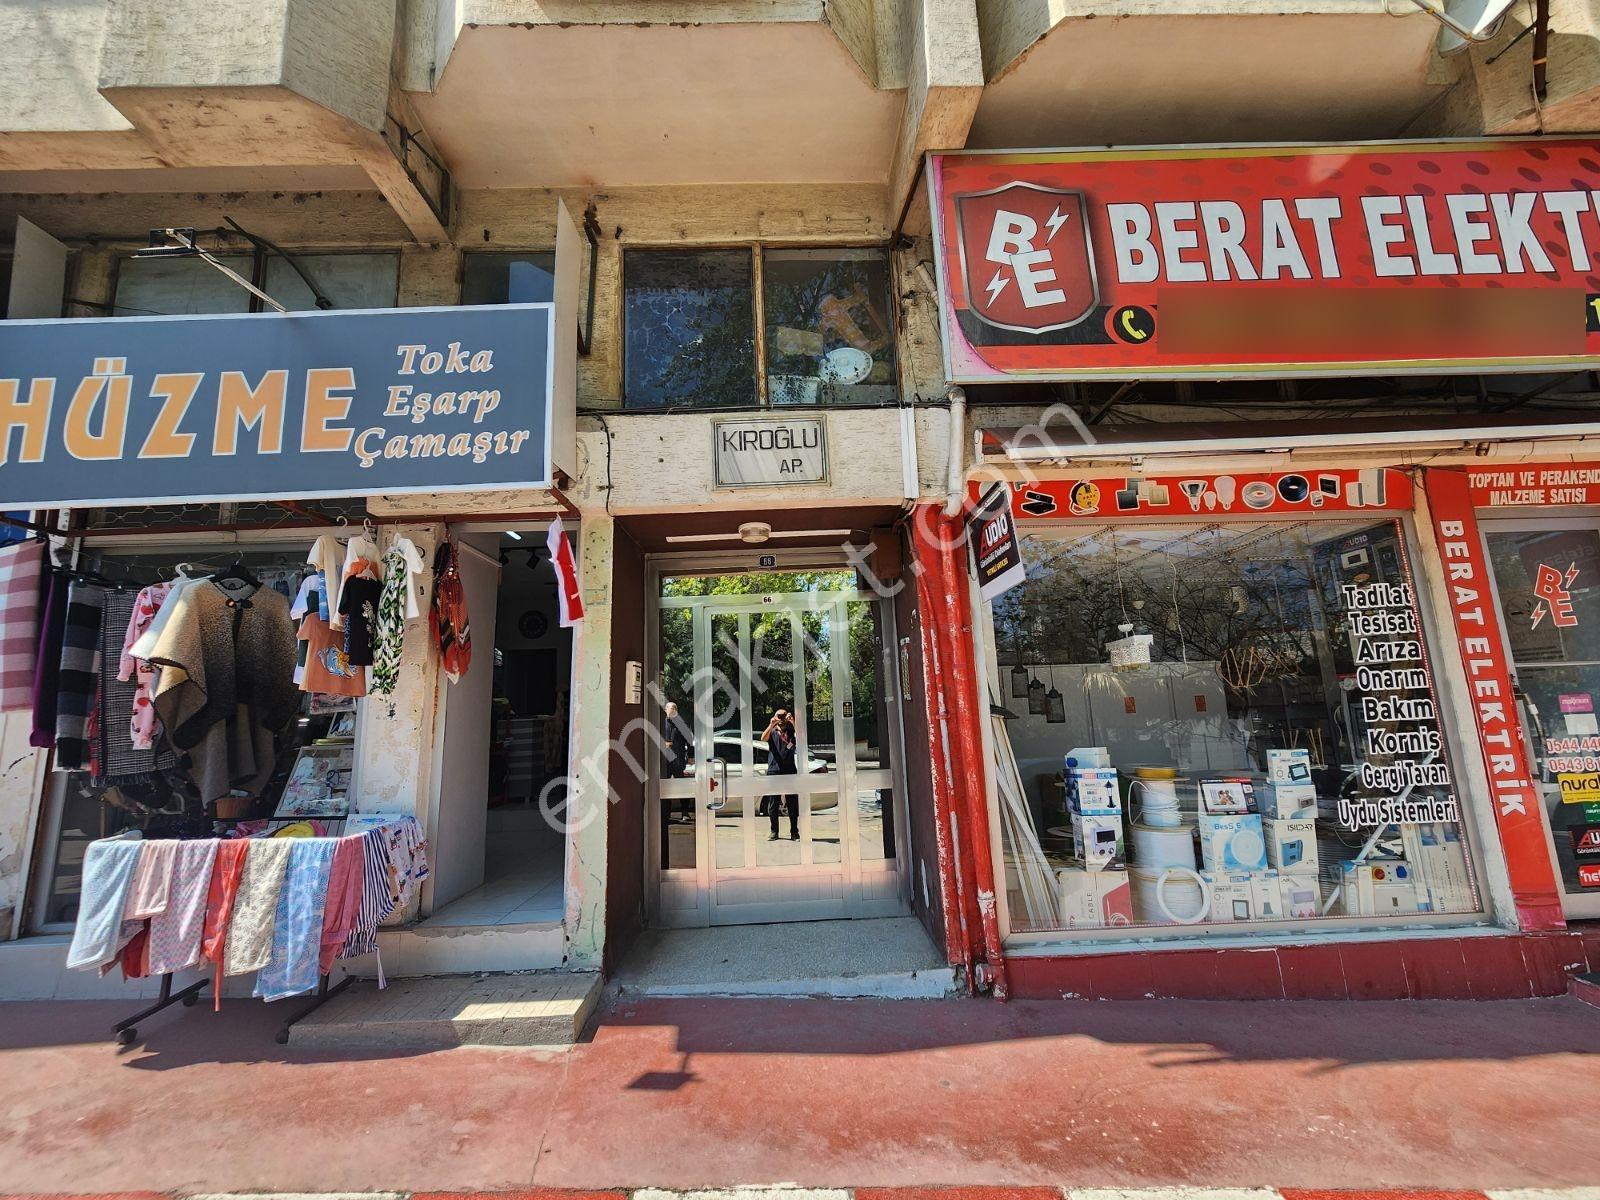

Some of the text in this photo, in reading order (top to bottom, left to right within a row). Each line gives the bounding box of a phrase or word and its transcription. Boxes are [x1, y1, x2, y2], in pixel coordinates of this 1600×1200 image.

[1107, 197, 1343, 284] BERAT
[396, 342, 494, 376] Toka
[0, 356, 357, 467] HÜZME
[383, 385, 502, 424] Eşarp
[354, 426, 530, 468] Çamaşır
[1469, 472, 1515, 489] TOPTAN
[1520, 471, 1536, 487] VE
[1490, 487, 1587, 506] MALZEME SATIŞI
[980, 513, 1009, 552] AUDIO
[1342, 582, 1412, 609] Tadilat
[1348, 610, 1417, 637] Tesisat
[1356, 639, 1422, 663] Arıza
[1357, 666, 1429, 691] Onarım
[1440, 520, 1528, 817] BERAT ELEKTRİK
[1362, 696, 1436, 723] Bakım
[1367, 728, 1442, 757] Korniş
[1581, 736, 1600, 752] 44
[1362, 760, 1450, 792] Gergi Tavan
[1548, 756, 1584, 773] 0543
[1337, 795, 1457, 832] Uydu Sistemleri
